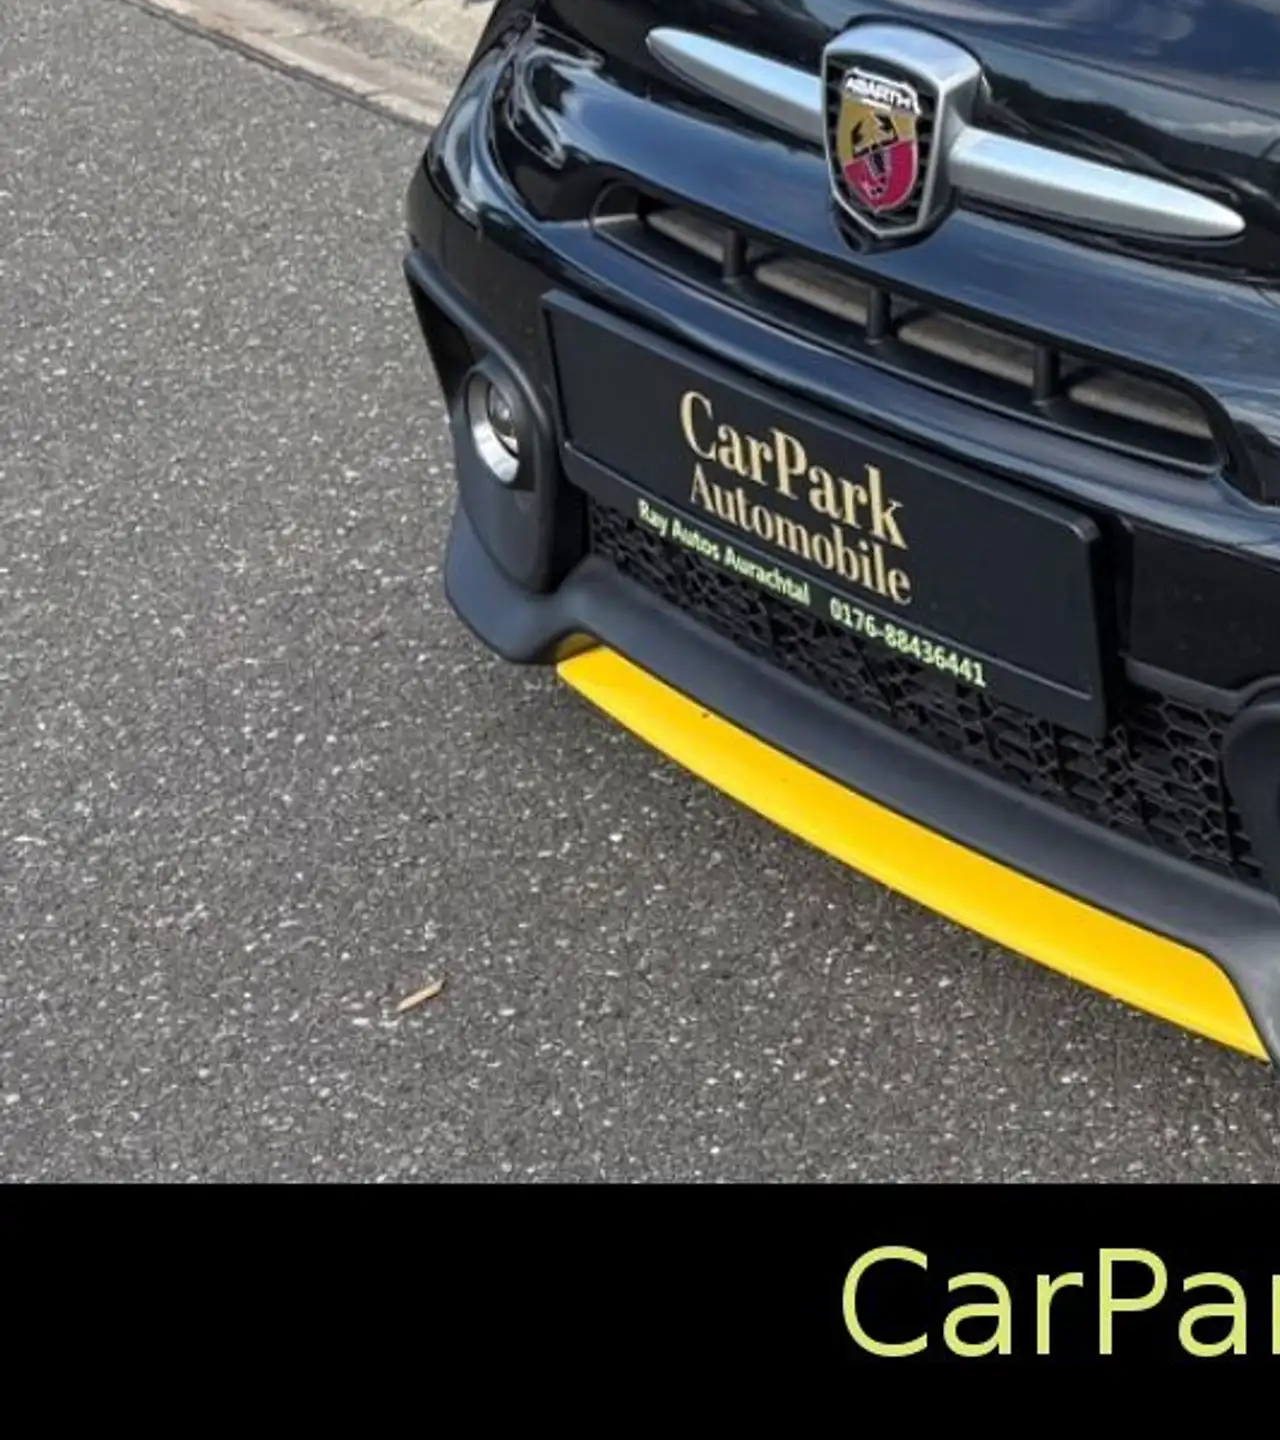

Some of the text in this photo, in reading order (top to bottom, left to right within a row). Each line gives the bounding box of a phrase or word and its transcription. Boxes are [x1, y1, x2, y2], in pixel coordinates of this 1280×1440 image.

[679, 390, 909, 550] CarPark
[689, 463, 913, 606] Automobile
[671, 517, 720, 561] Autos
[829, 596, 987, 689] 0176-88436441
